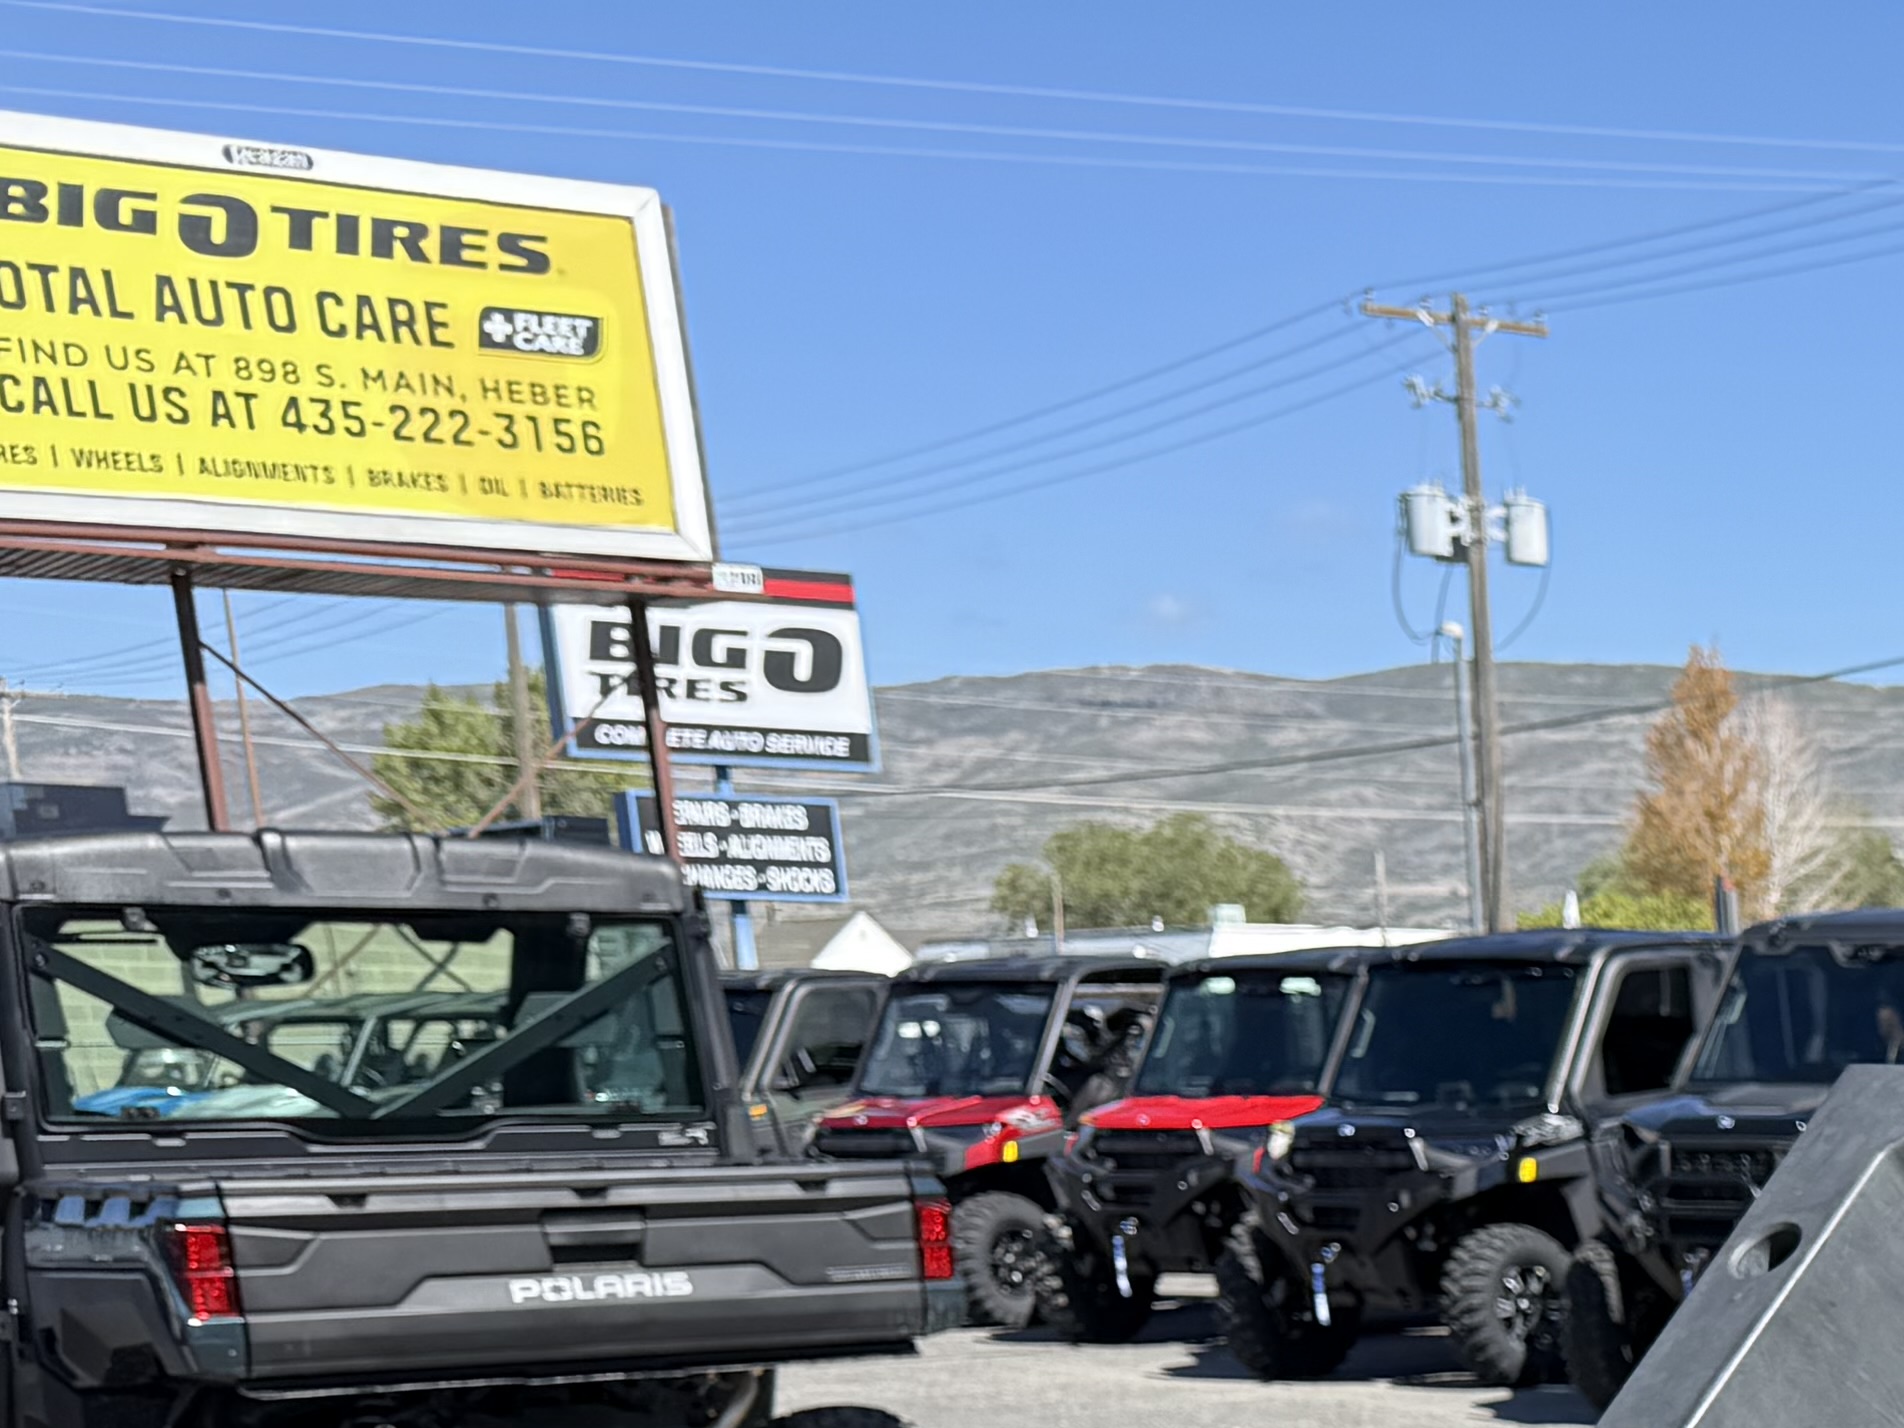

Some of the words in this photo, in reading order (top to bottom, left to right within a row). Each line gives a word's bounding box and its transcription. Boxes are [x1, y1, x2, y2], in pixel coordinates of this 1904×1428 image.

[0, 176, 158, 236] BIG
[269, 205, 551, 275] TIRES
[155, 274, 297, 334] AUTO
[315, 291, 456, 350] CARE
[512, 312, 593, 340] FLEET
[512, 332, 585, 356] CARE
[105, 344, 155, 374] US
[173, 351, 216, 379] AT
[234, 356, 300, 385] 898
[315, 363, 347, 389] S.
[360, 366, 468, 404] MAIN,
[479, 377, 598, 411] HEBER
[0, 373, 114, 421] CALL
[128, 381, 190, 426] US
[211, 389, 258, 431] AT
[281, 395, 606, 457] 435-222-3156
[70, 447, 164, 474] WHEELS
[198, 456, 336, 486] ALIGNMENTS
[367, 466, 449, 493] BRAKES
[478, 475, 509, 499] OIL
[537, 480, 645, 507] BATTERIES
[588, 619, 749, 670] BIG
[593, 722, 707, 750] COMETE
[706, 729, 765, 754] AUTO
[765, 732, 851, 758] SERVICE
[645, 829, 720, 859] WEELS
[727, 833, 832, 864] ALIGNMENTS
[509, 1270, 693, 1304] POLARIS
